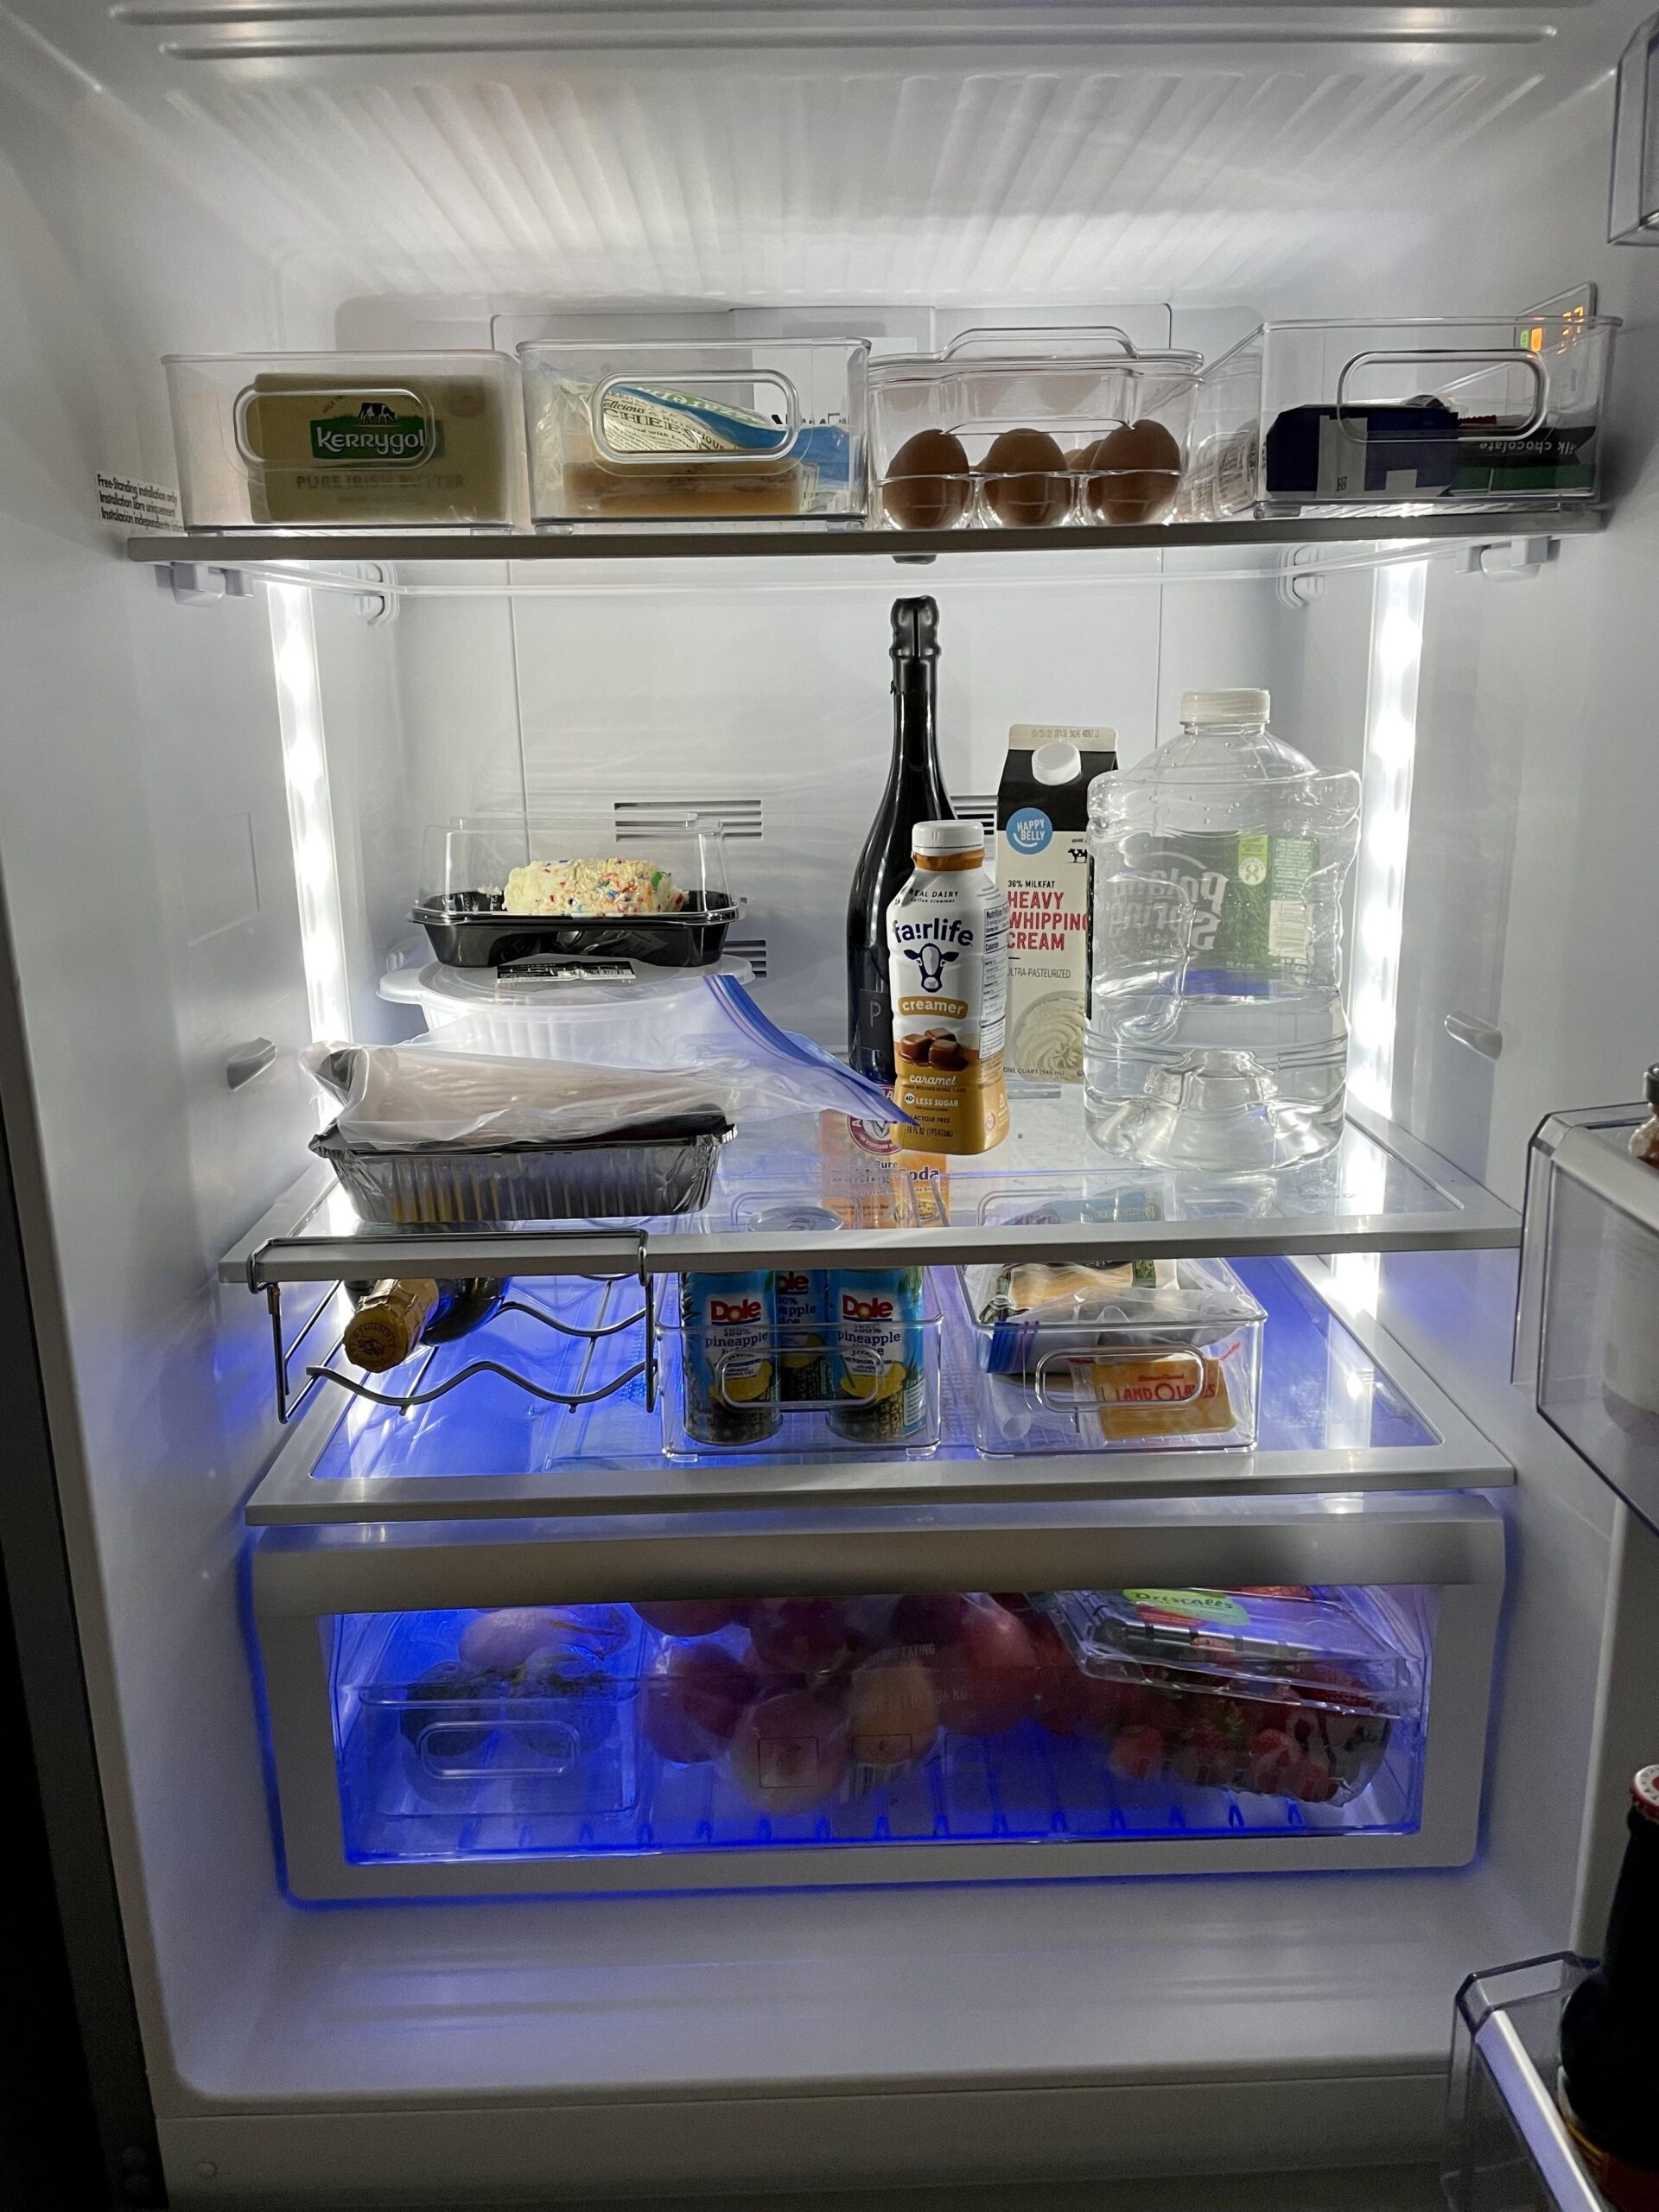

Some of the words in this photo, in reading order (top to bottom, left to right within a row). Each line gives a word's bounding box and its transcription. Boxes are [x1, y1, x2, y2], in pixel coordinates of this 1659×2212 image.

[316, 426, 426, 454] Kerrygol
[1479, 441, 1553, 454] chocolate
[1017, 818, 1045, 832] HAPPY
[1020, 830, 1046, 841] BELLY
[1007, 880, 1023, 888] 36%
[909, 888, 928, 897] REAL
[1007, 891, 1065, 910] HEAVY
[1007, 931, 1065, 951] CREAM
[902, 1000, 964, 1015] creamer
[909, 1075, 957, 1085] caramel
[916, 1096, 932, 1106] LESS
[779, 1271, 809, 1291] ole
[711, 1299, 761, 1322] Dole
[842, 1294, 893, 1320] Dole
[705, 1332, 768, 1348] pineapple
[838, 1331, 900, 1346] pineapple
